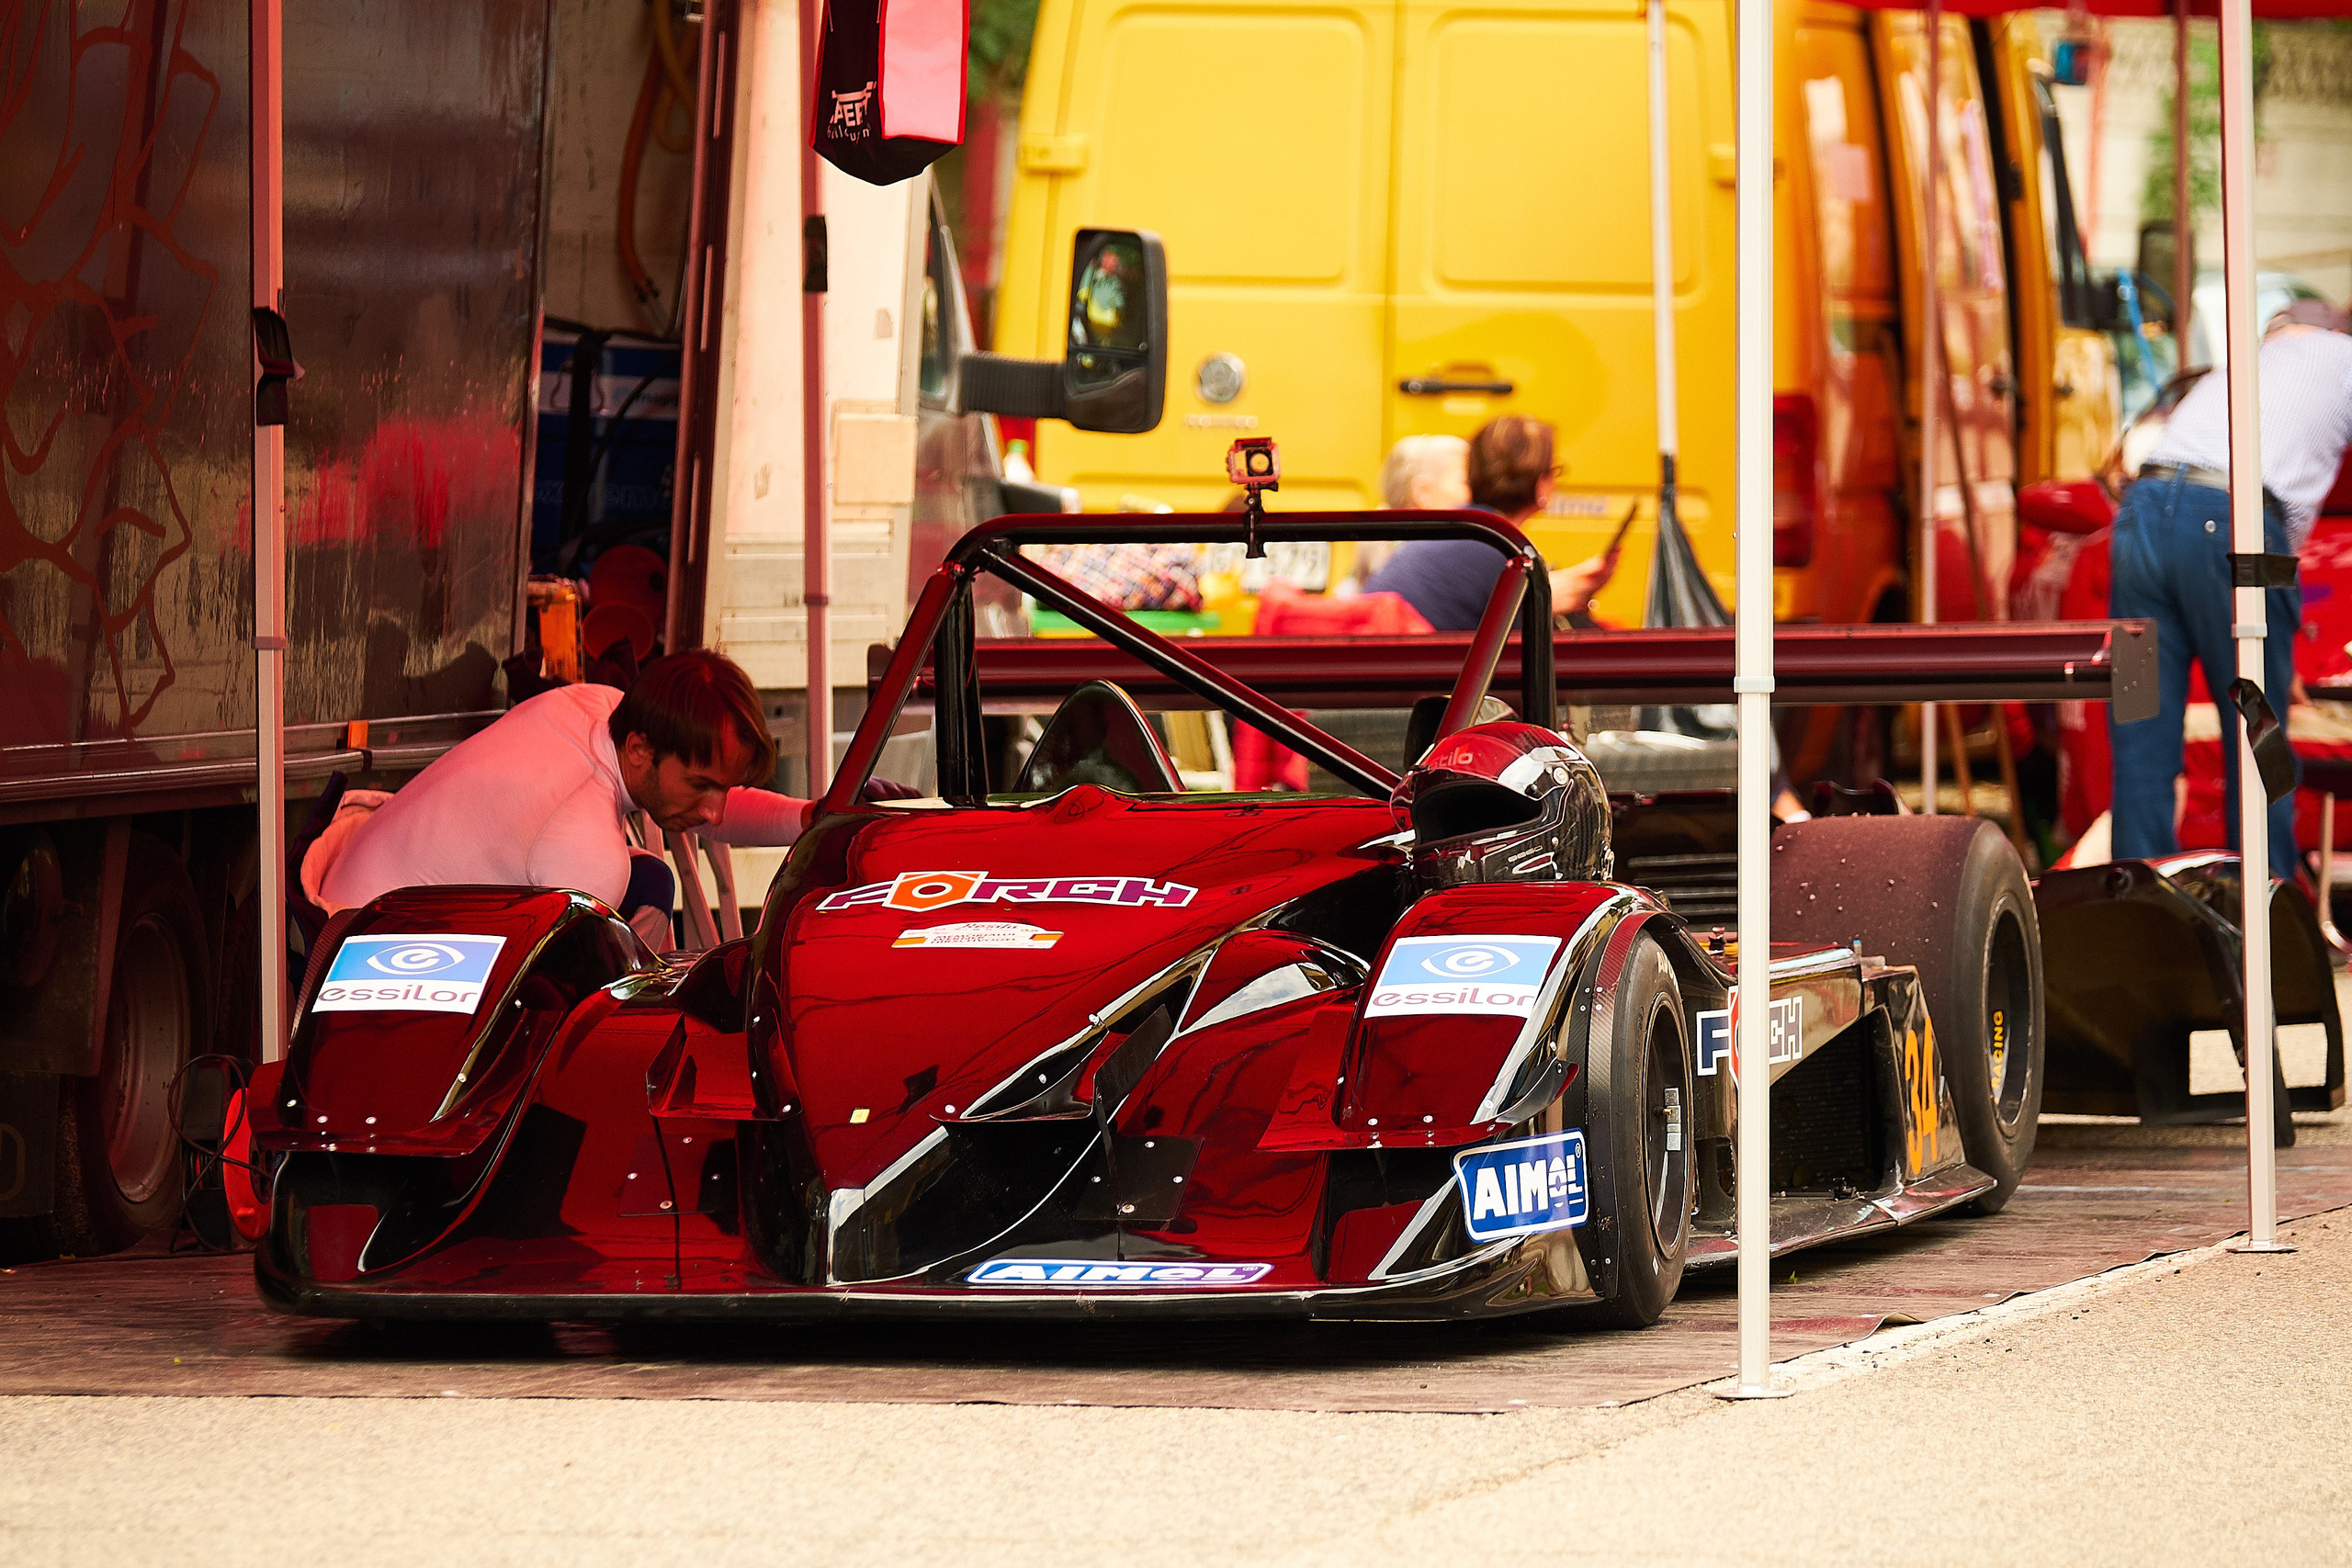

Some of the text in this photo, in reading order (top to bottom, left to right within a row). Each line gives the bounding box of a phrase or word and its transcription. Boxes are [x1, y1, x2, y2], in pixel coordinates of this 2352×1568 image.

[318, 984, 478, 1003] essilor
[1372, 987, 1535, 1007] essilor
[1696, 986, 1803, 1086] FCH
[1991, 1010, 2004, 1090] RACING
[1904, 1016, 1938, 1175] 34
[1473, 1154, 1584, 1220] AIMOL
[981, 1264, 1247, 1281] AIMOL
